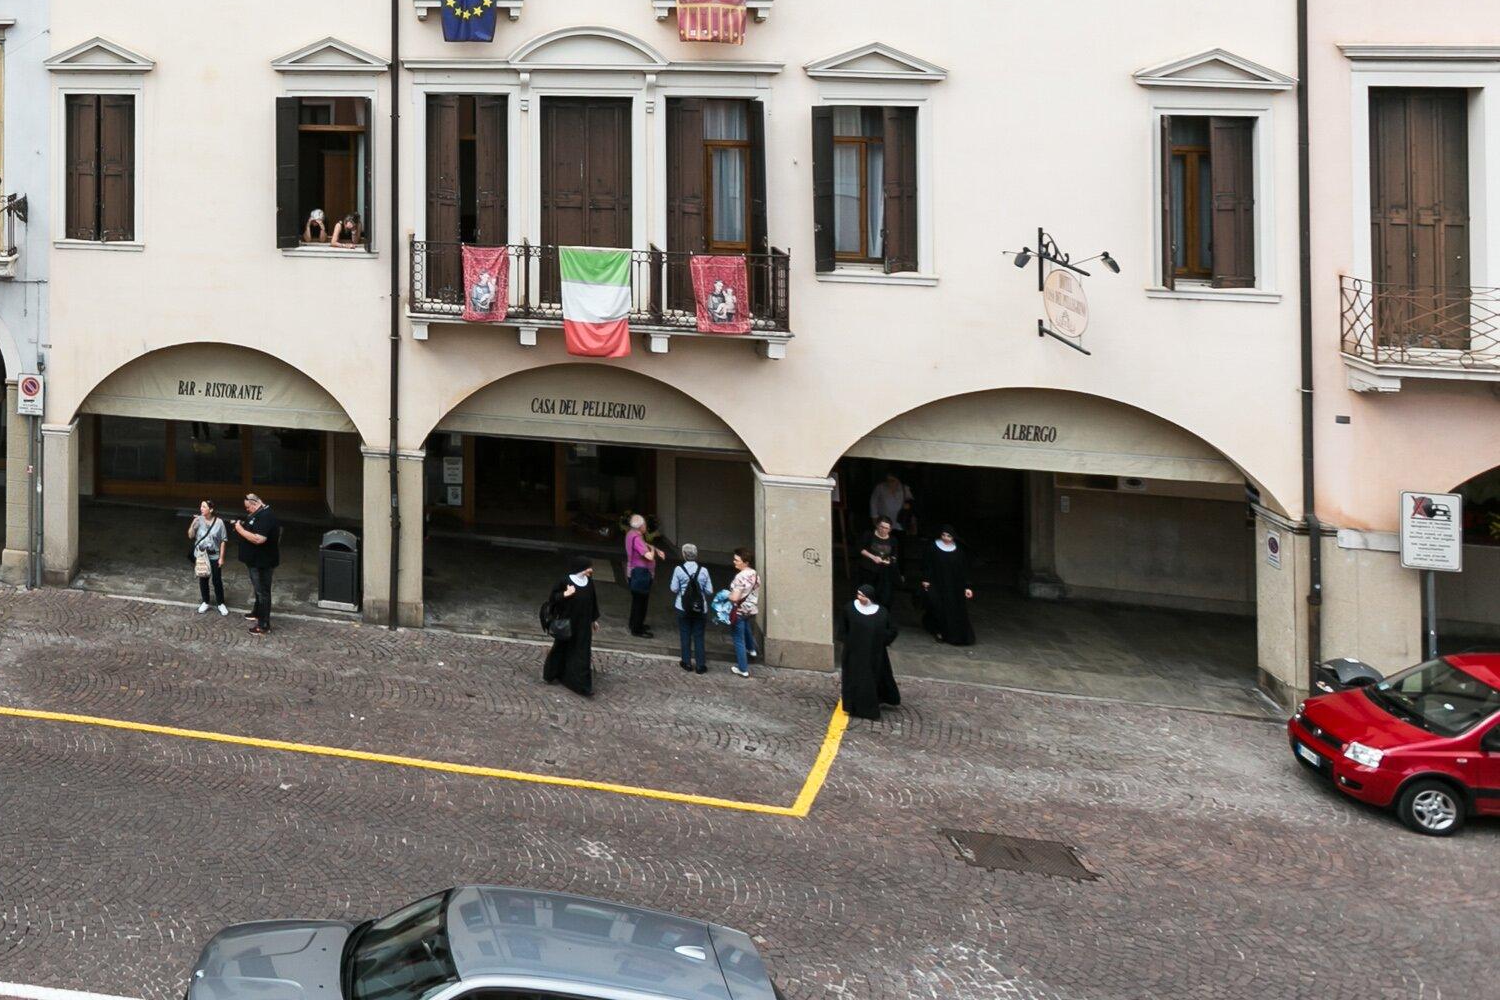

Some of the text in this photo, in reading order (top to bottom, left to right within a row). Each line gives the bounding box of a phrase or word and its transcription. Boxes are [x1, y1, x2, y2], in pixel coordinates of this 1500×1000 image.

[178, 380, 196, 396] BAR
[204, 382, 263, 400] RISTORANTE
[531, 397, 646, 421] CASA DEL PELLEGRINO
[1001, 423, 1057, 443] ALBERGO
